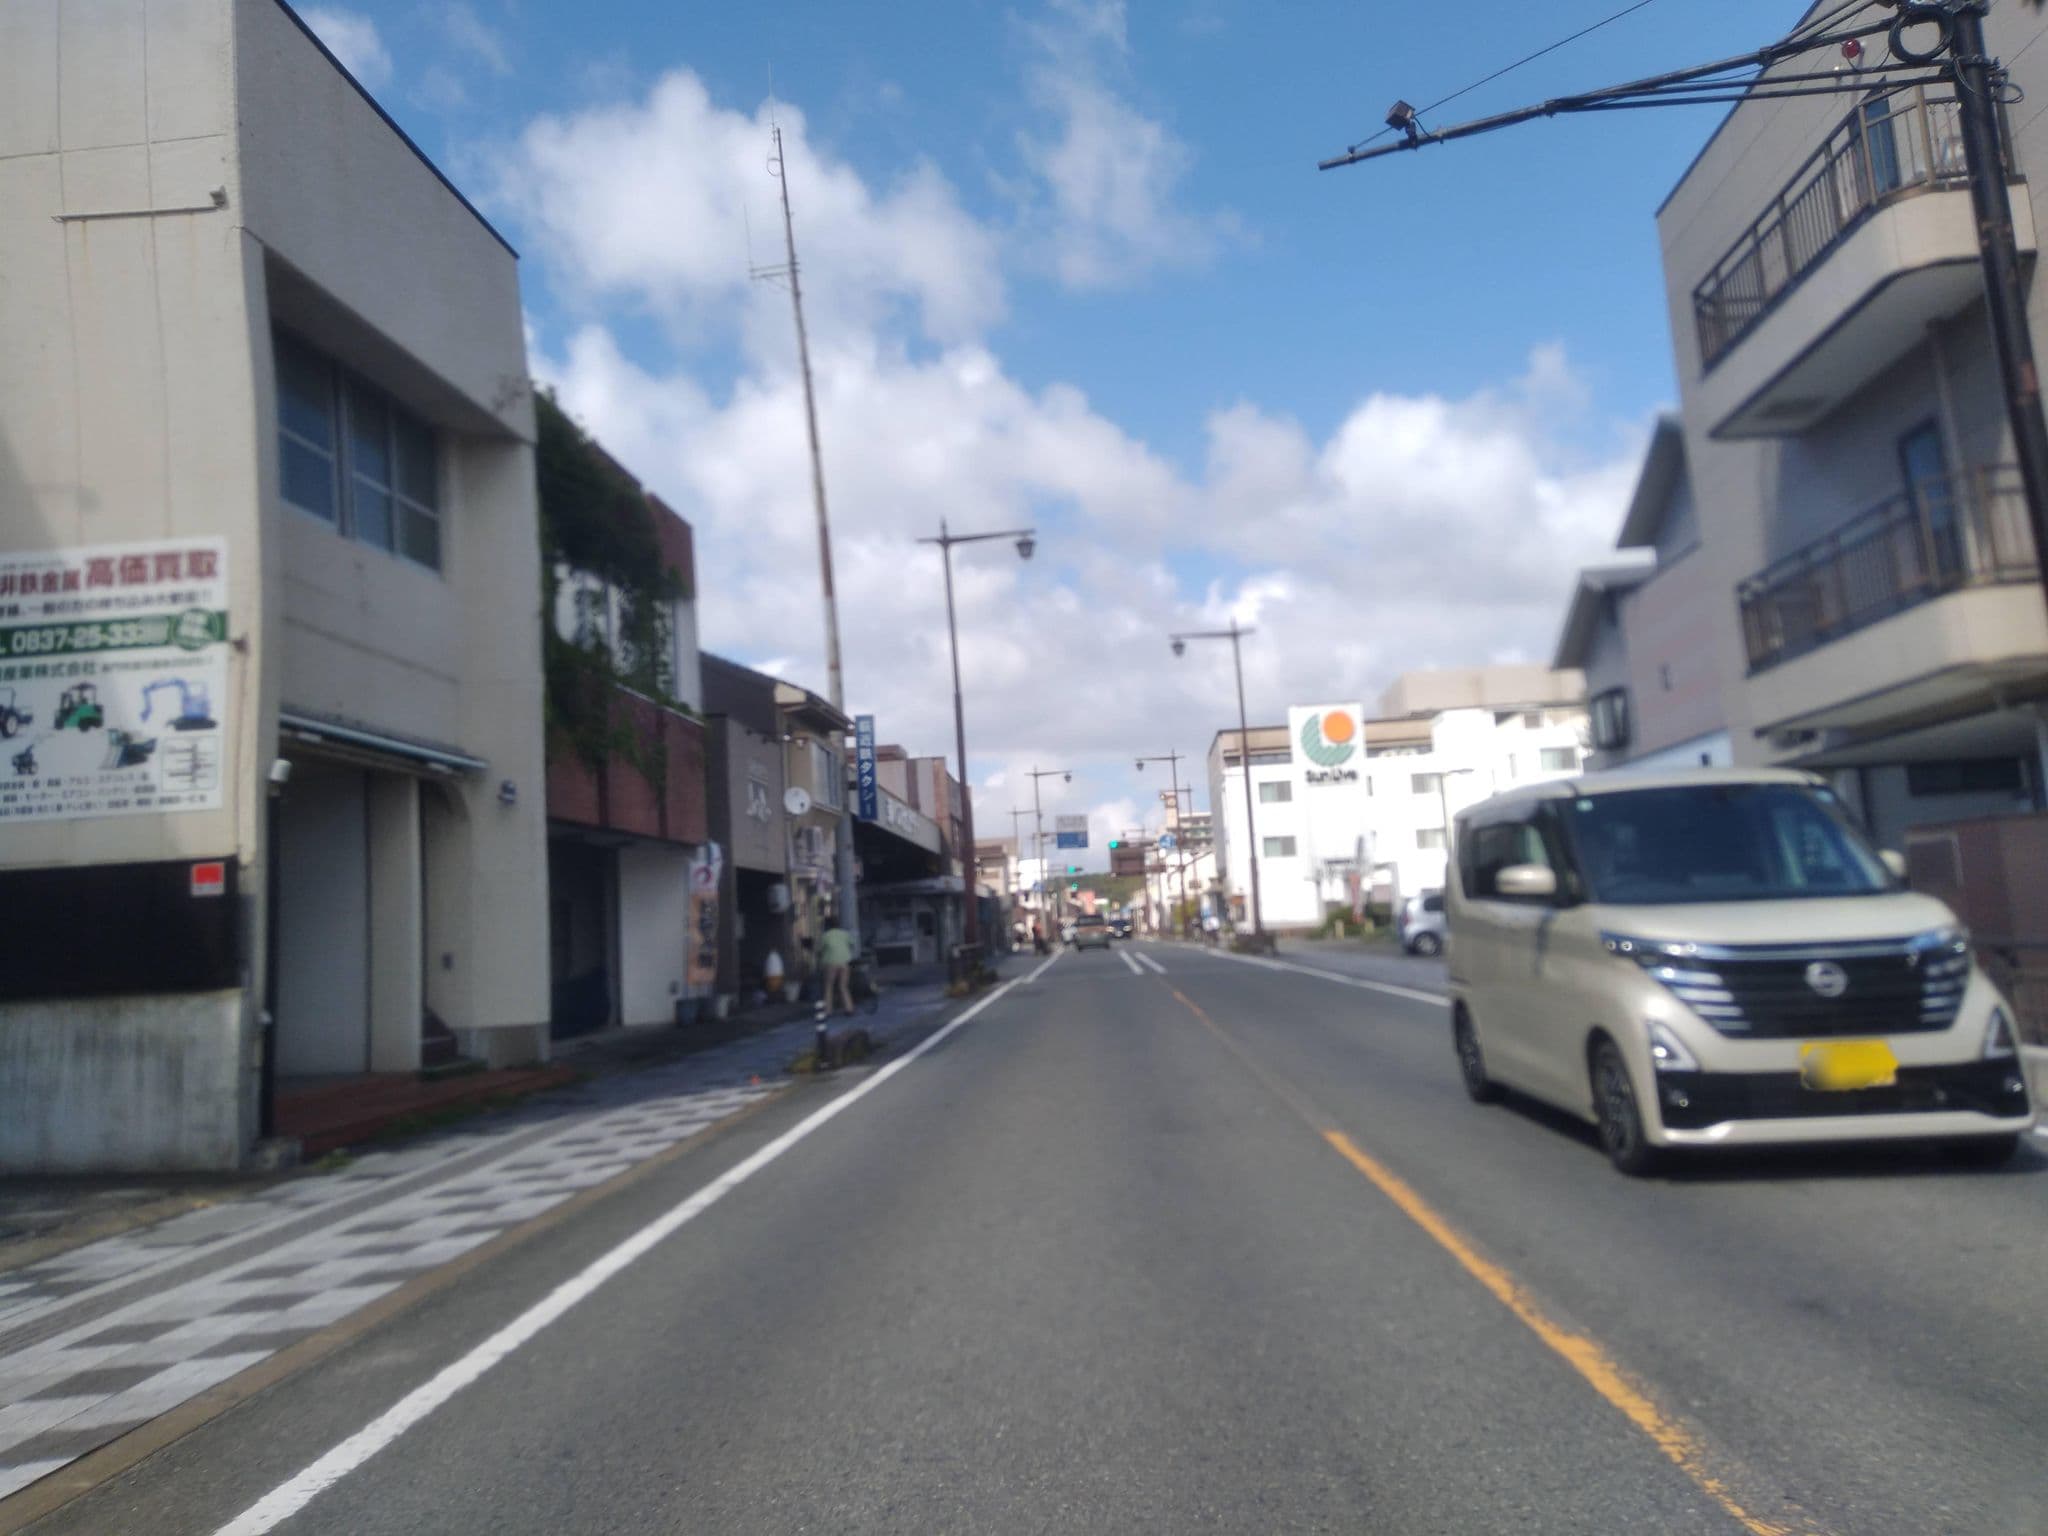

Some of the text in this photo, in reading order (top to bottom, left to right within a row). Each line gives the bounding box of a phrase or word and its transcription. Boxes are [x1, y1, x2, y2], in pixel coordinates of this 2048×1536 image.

[86, 550, 218, 587] 高価買取
[0, 662, 97, 682] 産業株式会社
